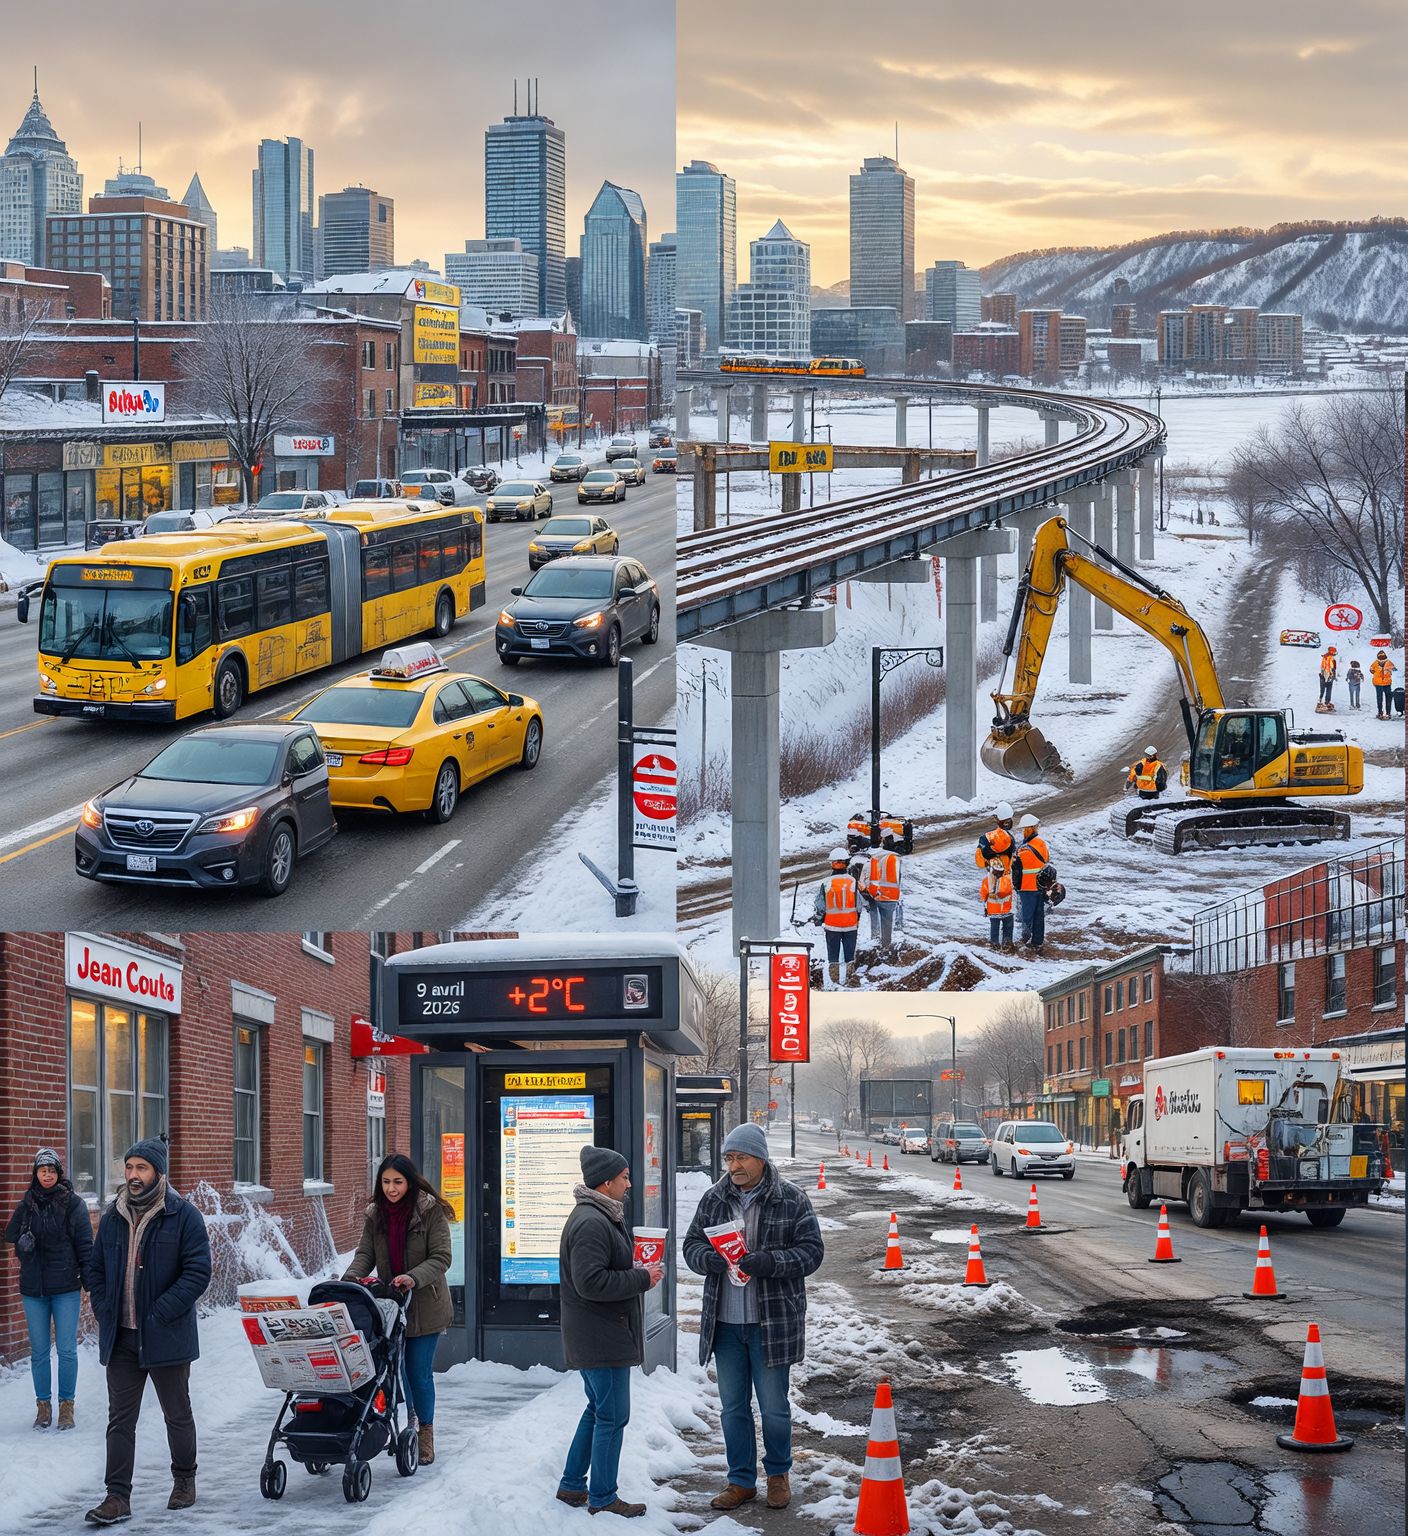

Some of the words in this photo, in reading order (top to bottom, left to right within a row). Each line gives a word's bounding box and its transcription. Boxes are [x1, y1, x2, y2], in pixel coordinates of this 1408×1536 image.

[77, 946, 122, 989] Jean
[417, 983, 427, 998] 9
[431, 980, 465, 997] avril
[508, 977, 585, 1013] +2°C
[422, 1001, 460, 1015] 2026
